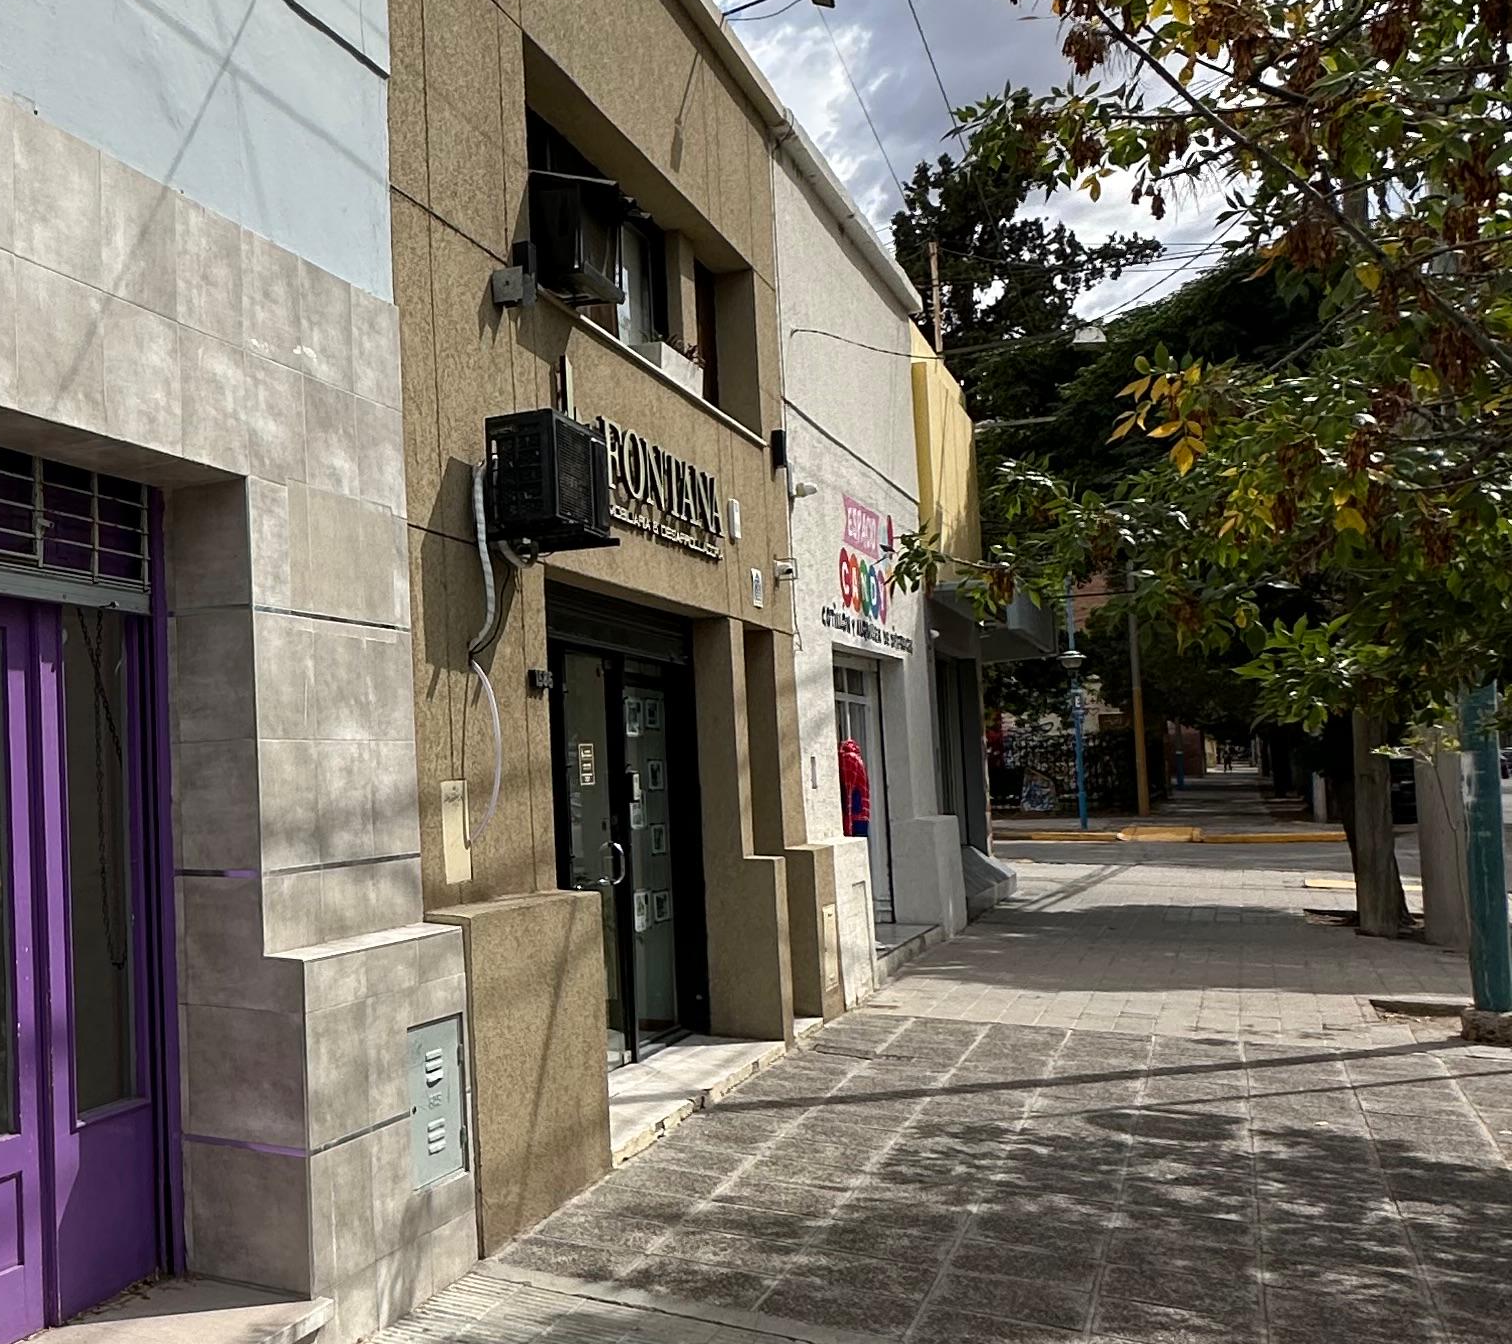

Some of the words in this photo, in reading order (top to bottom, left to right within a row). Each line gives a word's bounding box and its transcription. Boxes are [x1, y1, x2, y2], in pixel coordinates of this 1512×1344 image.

[598, 416, 725, 537] FONTANA
[847, 507, 877, 551] ESPACIO
[841, 559, 886, 614] CANDY
